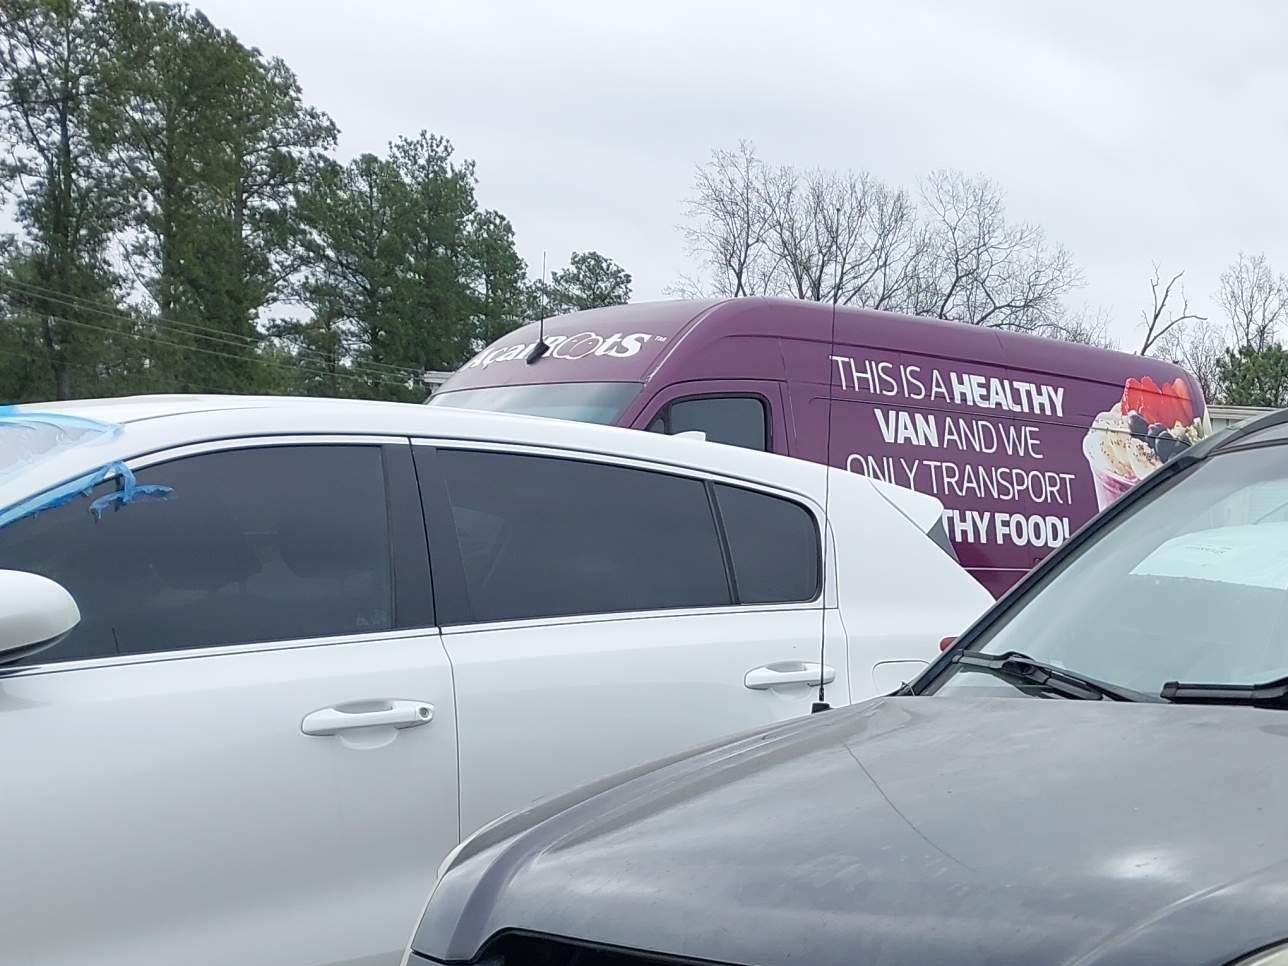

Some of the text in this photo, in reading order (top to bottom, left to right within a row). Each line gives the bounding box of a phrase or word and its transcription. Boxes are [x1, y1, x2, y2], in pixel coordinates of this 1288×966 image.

[829, 355, 1064, 418] THIS IS A HEALTHY
[874, 408, 1044, 459] VAN AND WE
[846, 453, 1076, 505] ONLY TRANSPORT
[942, 508, 1070, 549] THY FOOD!
